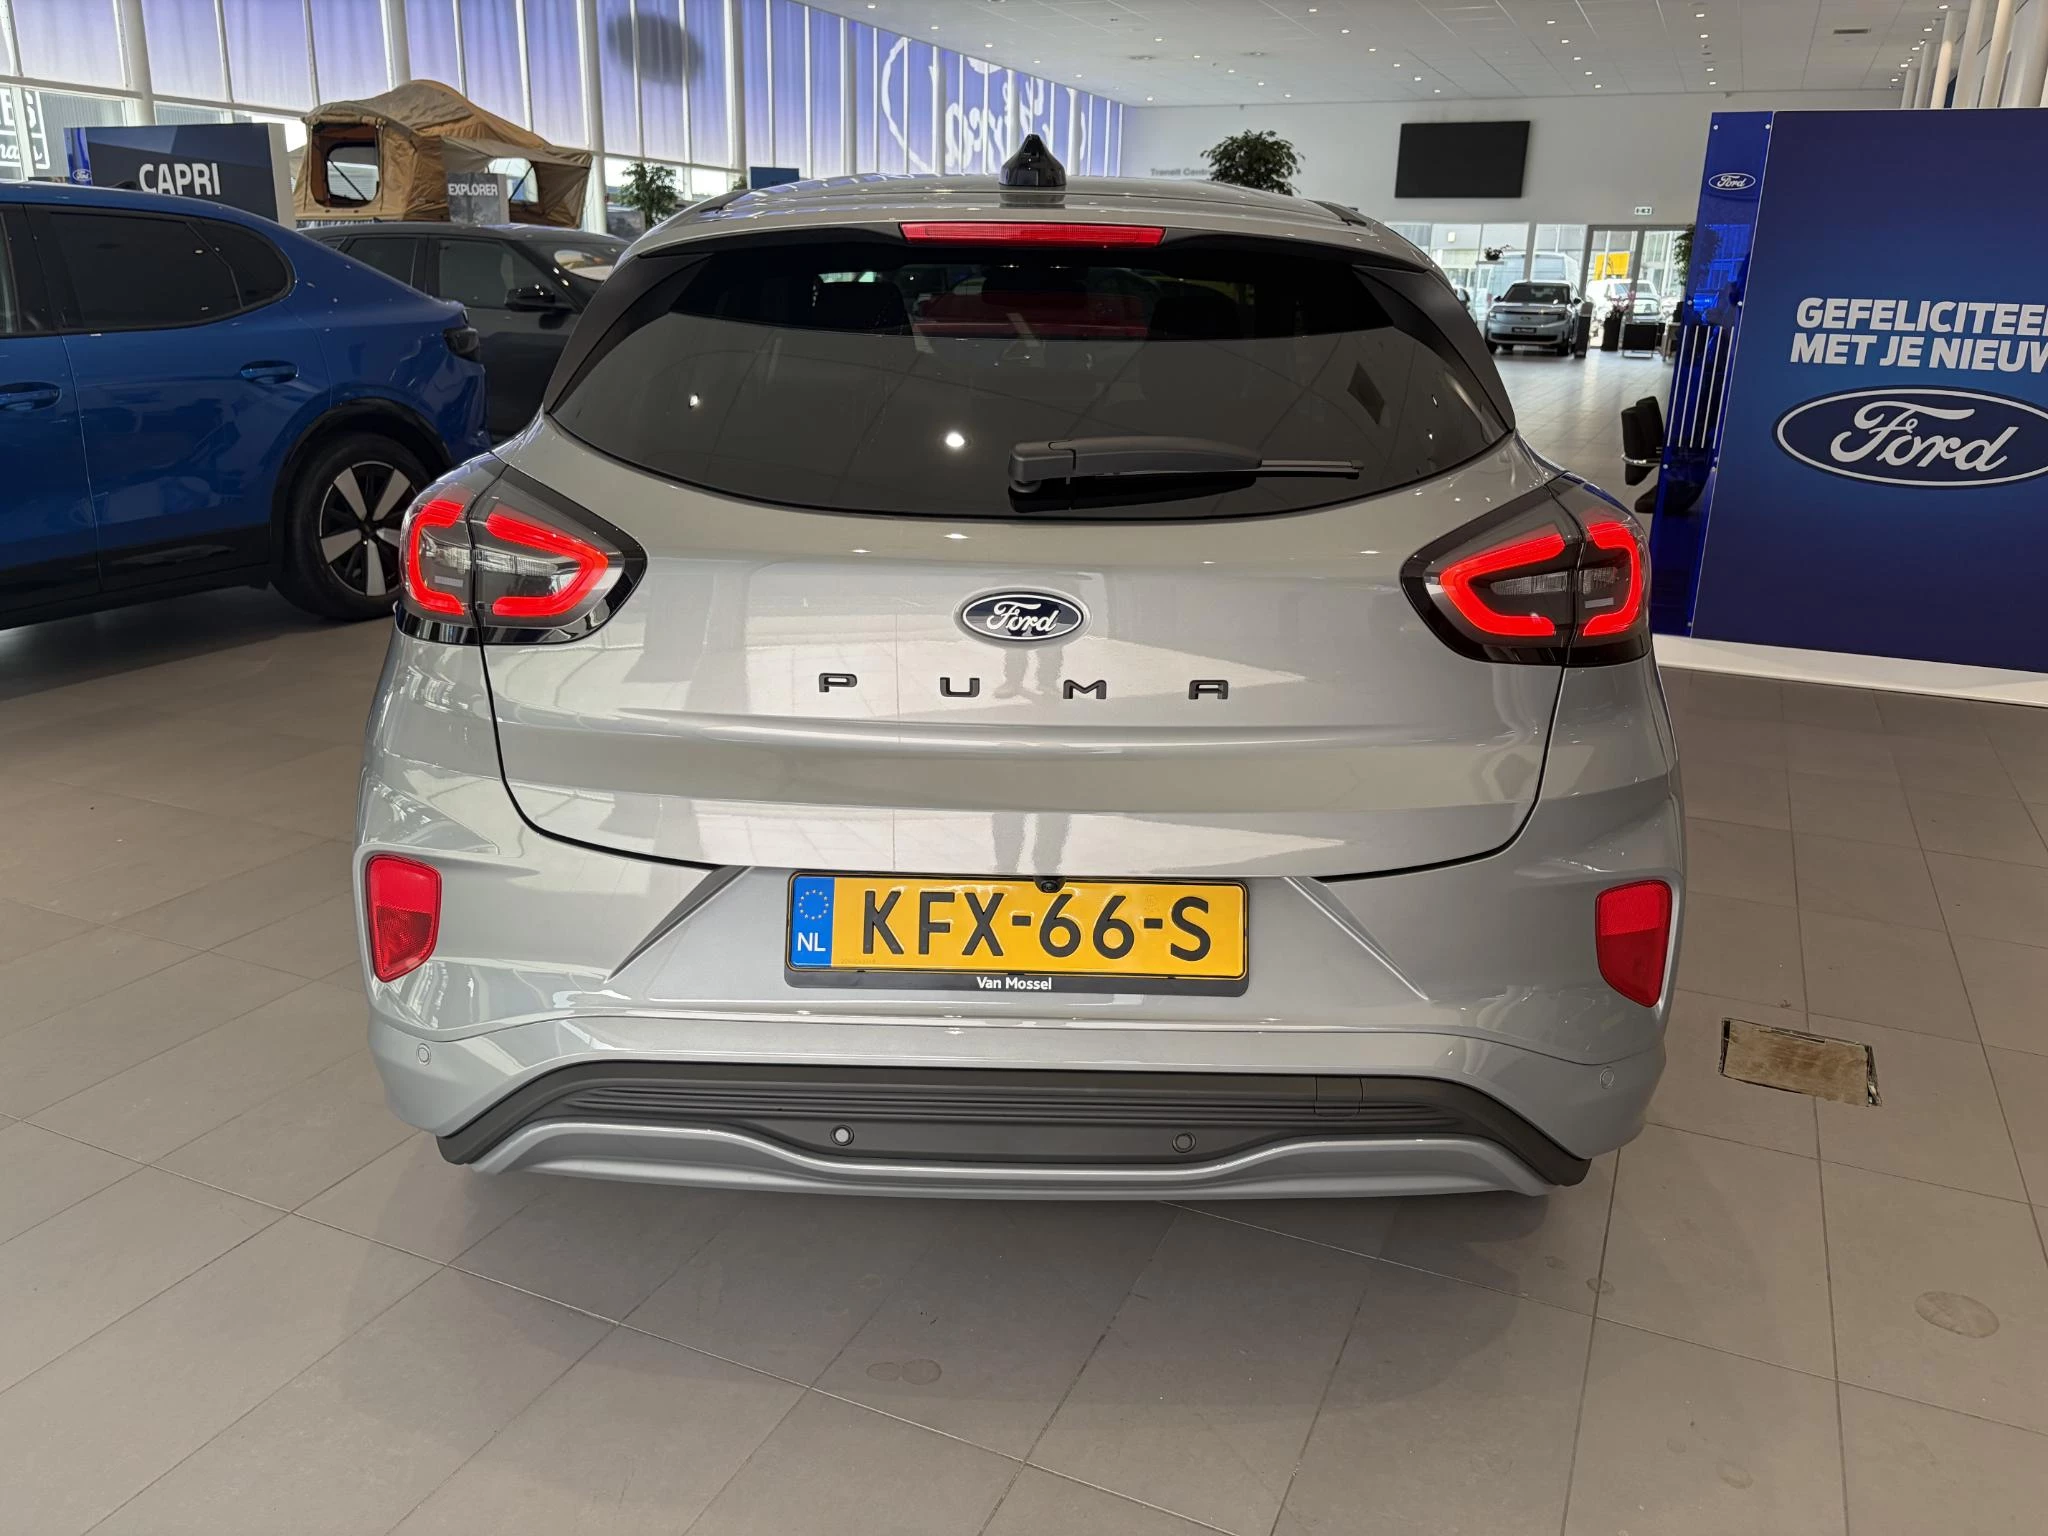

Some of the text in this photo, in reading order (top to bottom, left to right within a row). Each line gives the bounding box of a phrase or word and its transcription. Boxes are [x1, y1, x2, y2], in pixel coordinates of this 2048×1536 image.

[139, 163, 221, 195] CAPRI
[448, 183, 498, 196] EXPLORER
[1717, 175, 1747, 187] Ford
[1796, 297, 2048, 336] GEFELICITEE
[1790, 332, 1878, 365] MET
[1879, 336, 1925, 368] JE
[1830, 400, 2019, 472] Ford
[986, 601, 1060, 632] Ford
[818, 672, 1229, 700] PUMA
[862, 890, 1212, 962] KFX-66-S
[797, 932, 826, 952] NL
[976, 976, 1052, 990] Van Mossel
